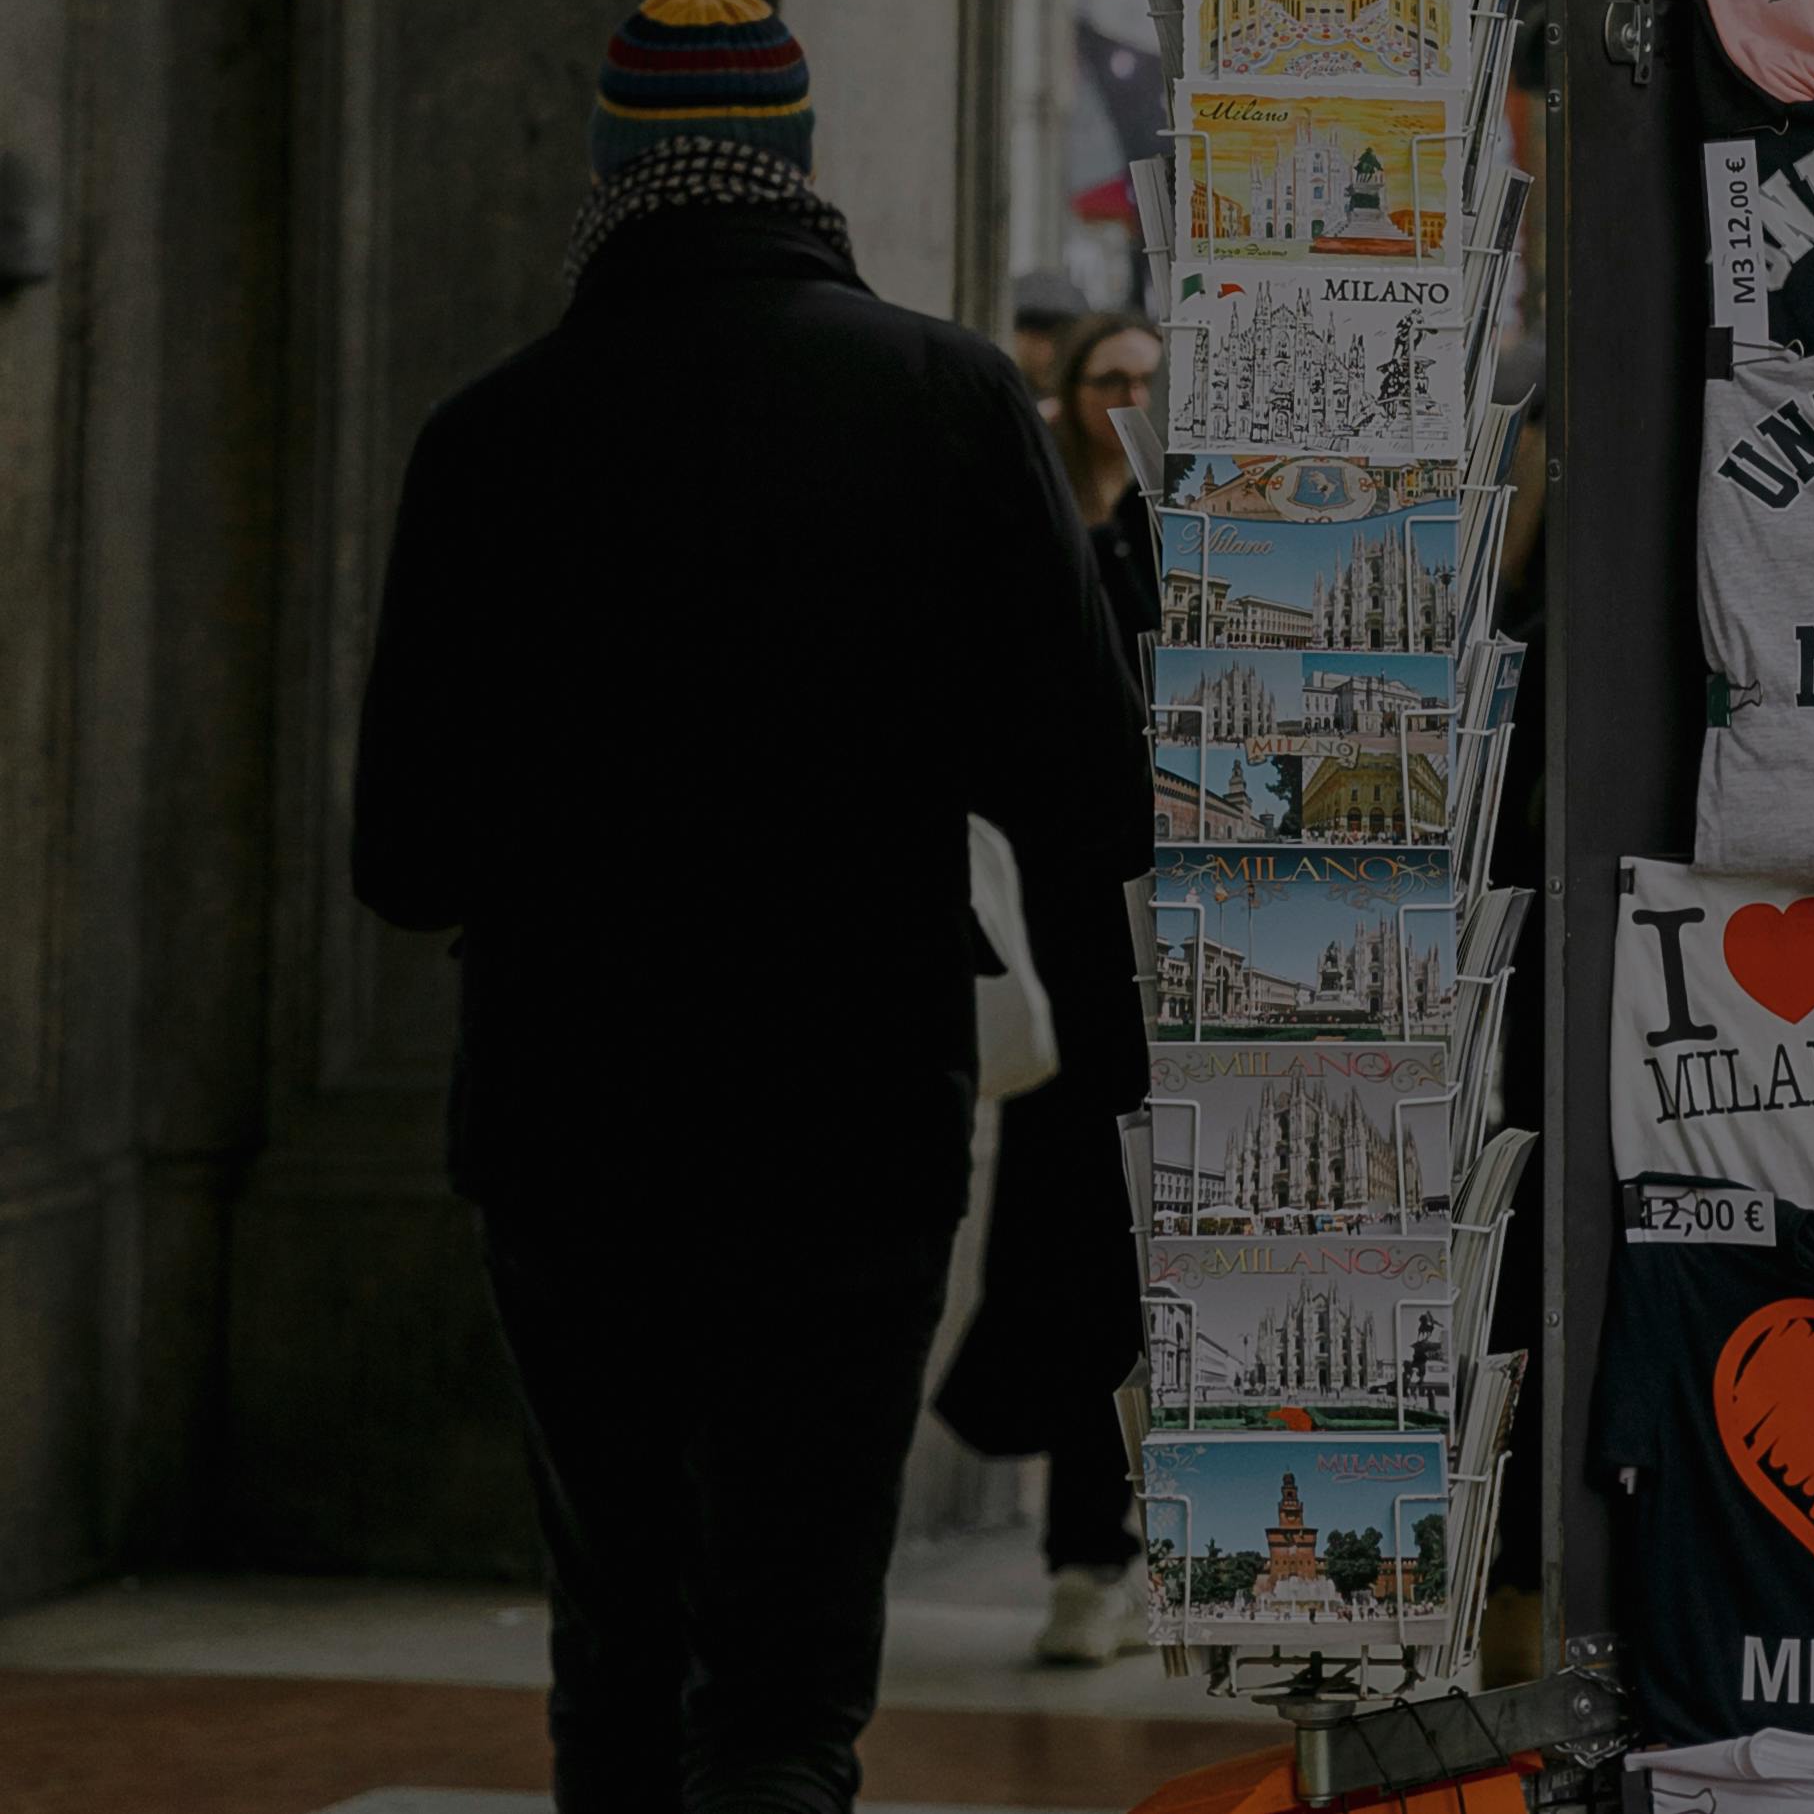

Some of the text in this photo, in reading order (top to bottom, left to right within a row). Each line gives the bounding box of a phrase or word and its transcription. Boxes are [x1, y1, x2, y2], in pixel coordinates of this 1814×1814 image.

[1198, 96, 1289, 124] Milano
[1725, 156, 1756, 304] M3 12,00 €
[1321, 278, 1450, 305] MILANO
[1250, 736, 1355, 760] MILANO
[1212, 855, 1399, 883] MILANO
[1631, 906, 1718, 1048] I
[1206, 1049, 1393, 1079] MILANO
[1744, 1200, 1765, 1232] €
[1209, 1245, 1393, 1276] MILANO
[1314, 1452, 1426, 1475] MILANO
